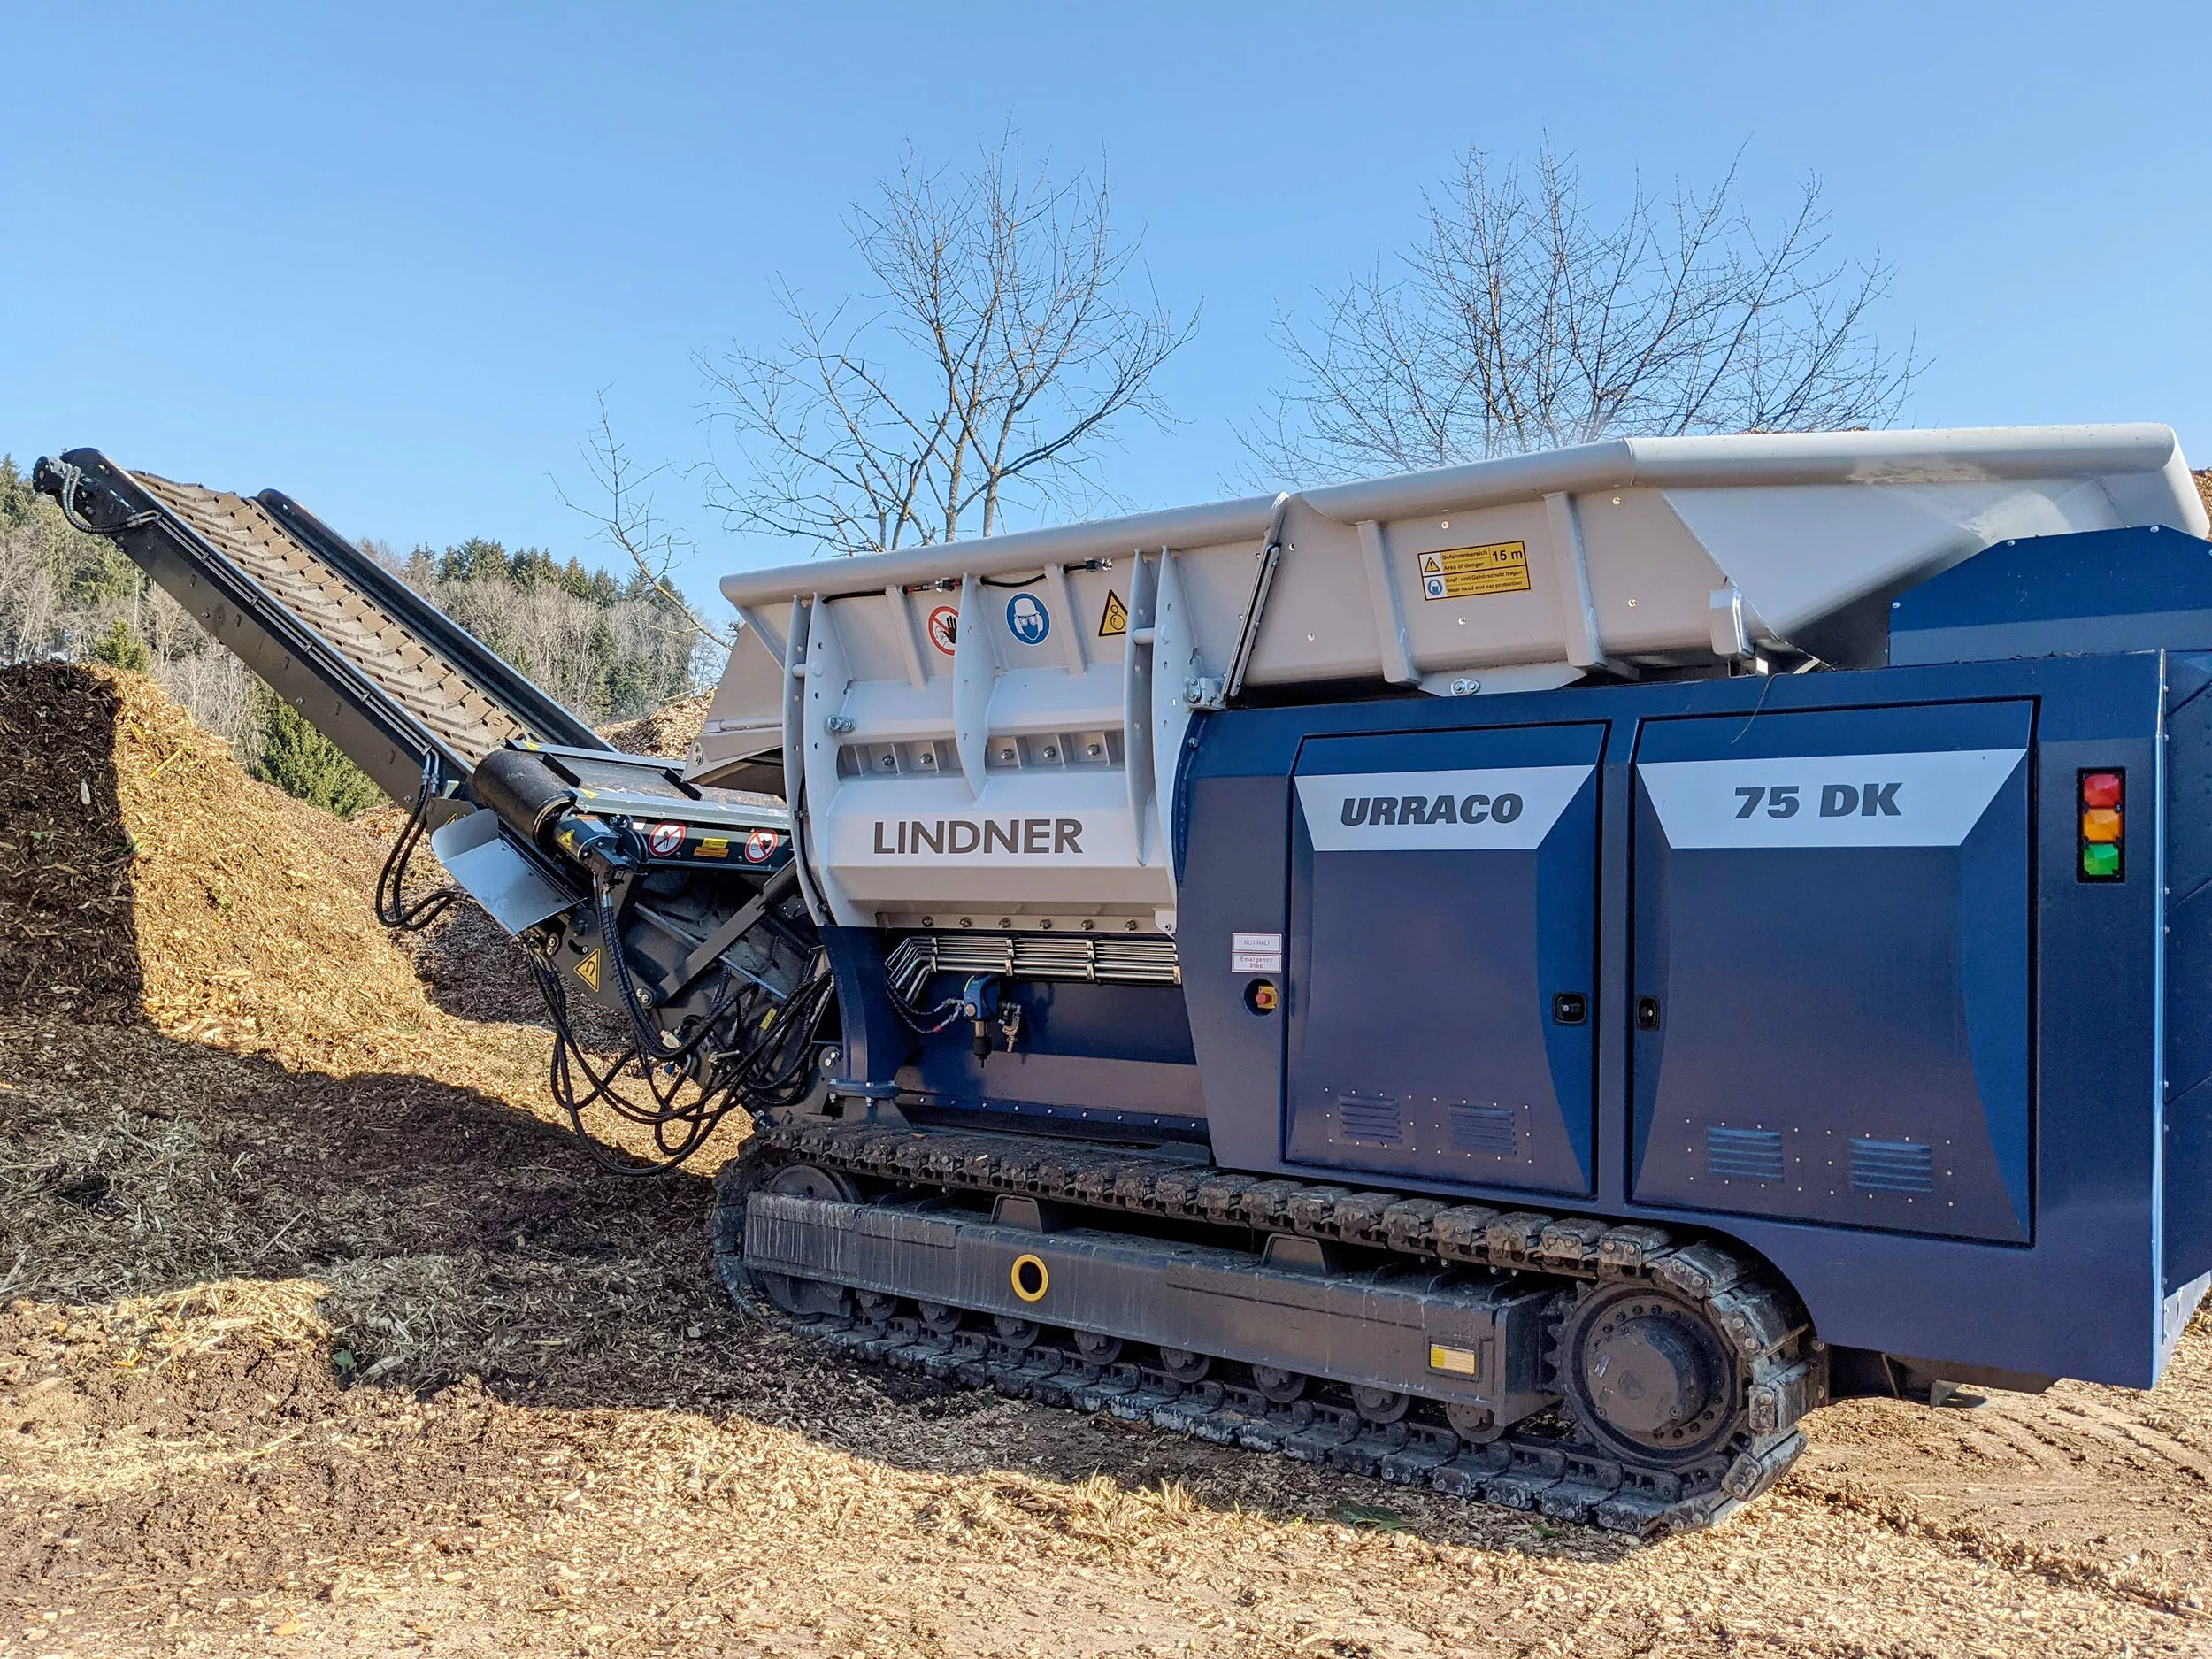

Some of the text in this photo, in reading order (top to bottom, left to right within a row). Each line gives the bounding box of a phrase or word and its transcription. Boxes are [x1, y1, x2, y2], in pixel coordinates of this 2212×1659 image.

[1442, 550, 1488, 560] Gefahrenbereich
[1492, 550, 1523, 561] 15 m
[1340, 793, 1523, 826] URRACO
[1734, 782, 1903, 819] 75 DK
[873, 818, 1083, 854] LINDNER
